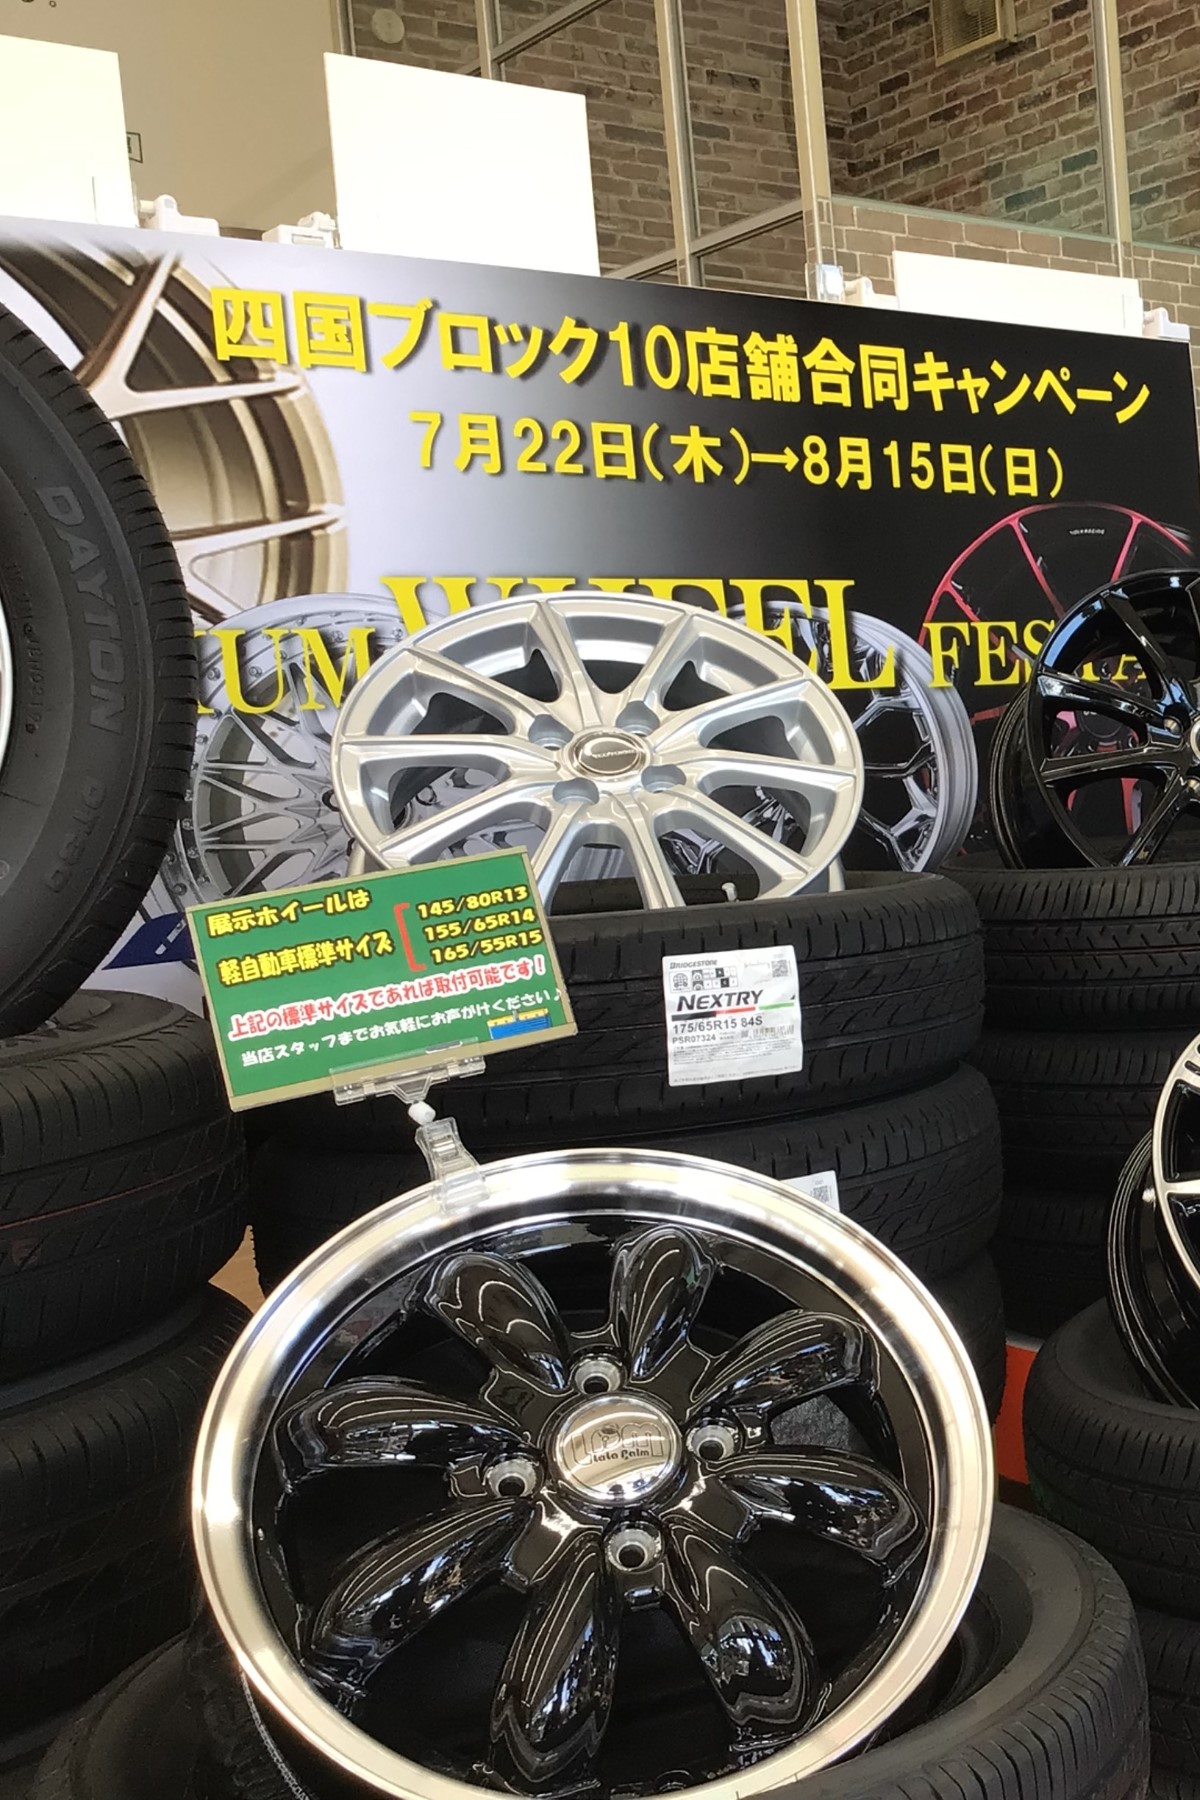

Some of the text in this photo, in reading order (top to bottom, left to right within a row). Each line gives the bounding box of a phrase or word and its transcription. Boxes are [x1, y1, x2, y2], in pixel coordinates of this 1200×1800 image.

[211, 286, 1151, 424] 四国ブロック10店舗合同キャンペーン
[36, 485, 129, 735] DAYTON
[207, 888, 371, 938] 展示ホイールは
[416, 885, 529, 921] 145/80R13
[424, 908, 537, 943] 155/65R14
[217, 930, 395, 987] 軽自動車標準サイズ
[430, 929, 545, 965] 165/55R15
[676, 989, 764, 1012] NEXTRY
[673, 1015, 764, 1034] 175/65R15 84S
